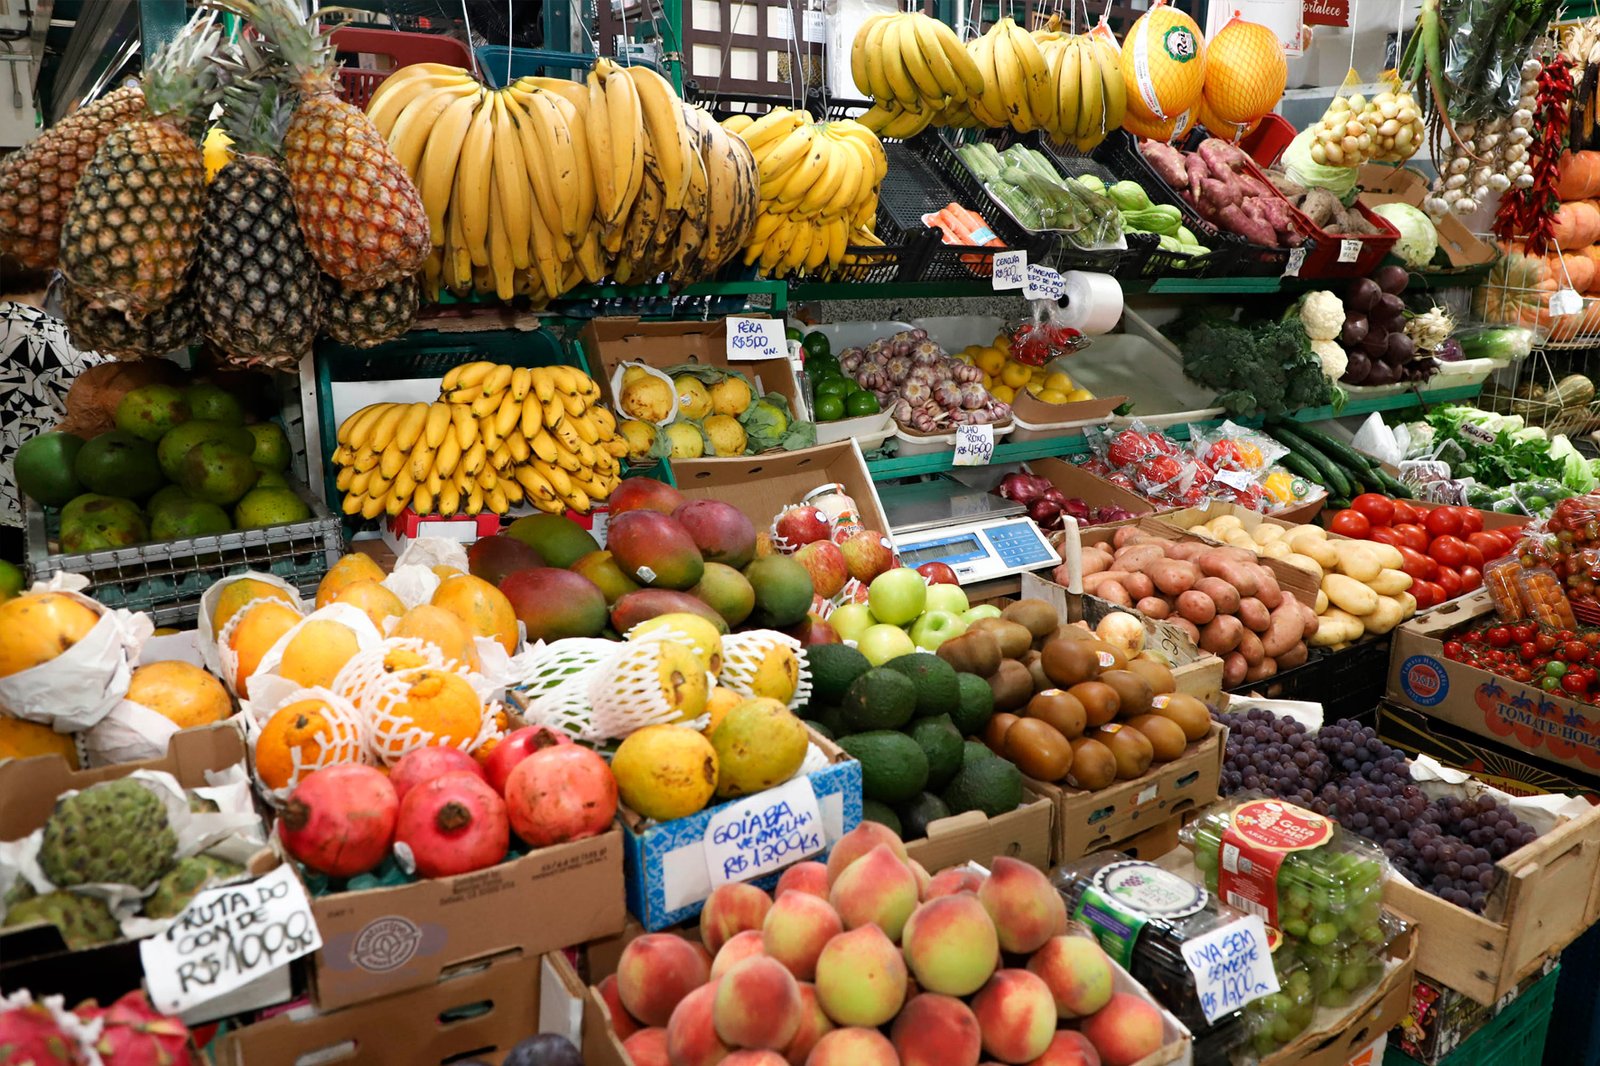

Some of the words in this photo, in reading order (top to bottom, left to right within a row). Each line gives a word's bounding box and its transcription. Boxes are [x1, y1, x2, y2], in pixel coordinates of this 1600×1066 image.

[1303, 0, 1341, 17] ortalece
[1177, 33, 1188, 55] Rei
[737, 320, 763, 333] PÊRA
[1498, 702, 1558, 735] TOMATE
[713, 801, 794, 845] GOIABA
[1279, 819, 1316, 838] Gota
[257, 881, 289, 904] DO
[1189, 943, 1223, 968] UVA
[1222, 929, 1257, 957] SEM
